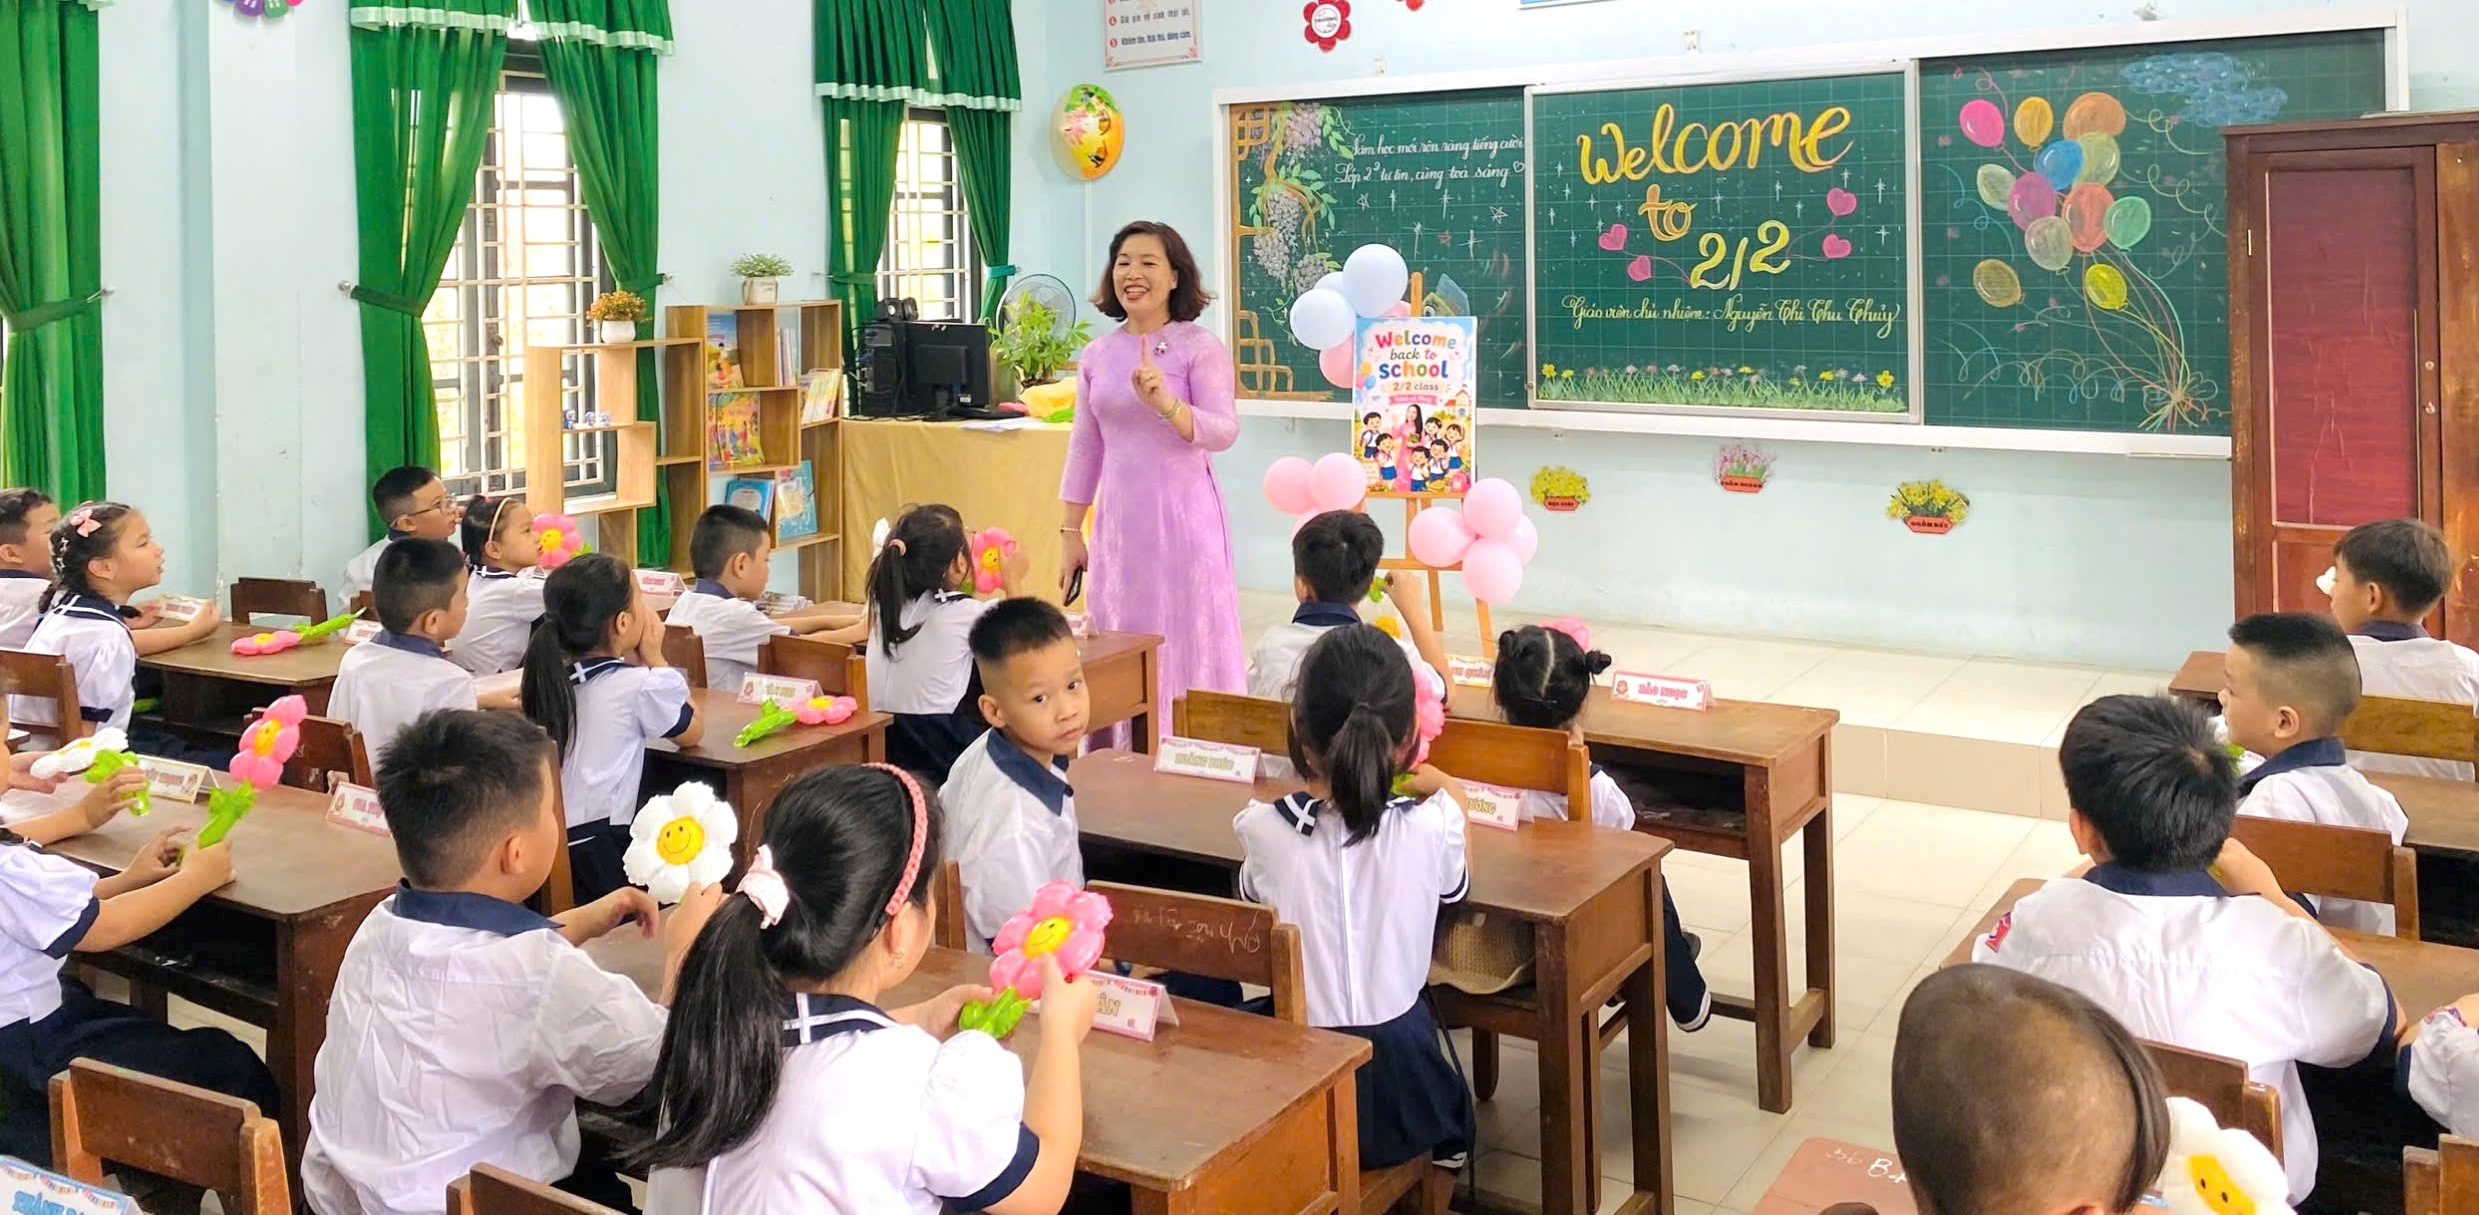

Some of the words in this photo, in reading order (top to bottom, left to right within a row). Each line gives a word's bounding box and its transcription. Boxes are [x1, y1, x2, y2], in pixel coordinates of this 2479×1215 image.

[1577, 103, 1854, 185] Welcome
[1473, 163, 1510, 188] sáng
[1638, 184, 1698, 242] to
[1689, 219, 1792, 291] 2/2
[1562, 294, 1603, 330] Giáo
[1713, 293, 1774, 333] Nguyễn
[1807, 298, 1844, 326] Thu
[1375, 330, 1457, 350] Welcome
[1390, 348, 1421, 360] back
[1424, 349, 1437, 360] to
[1379, 360, 1449, 379] school
[1393, 381, 1412, 391] 2/2
[1414, 381, 1440, 391] class
